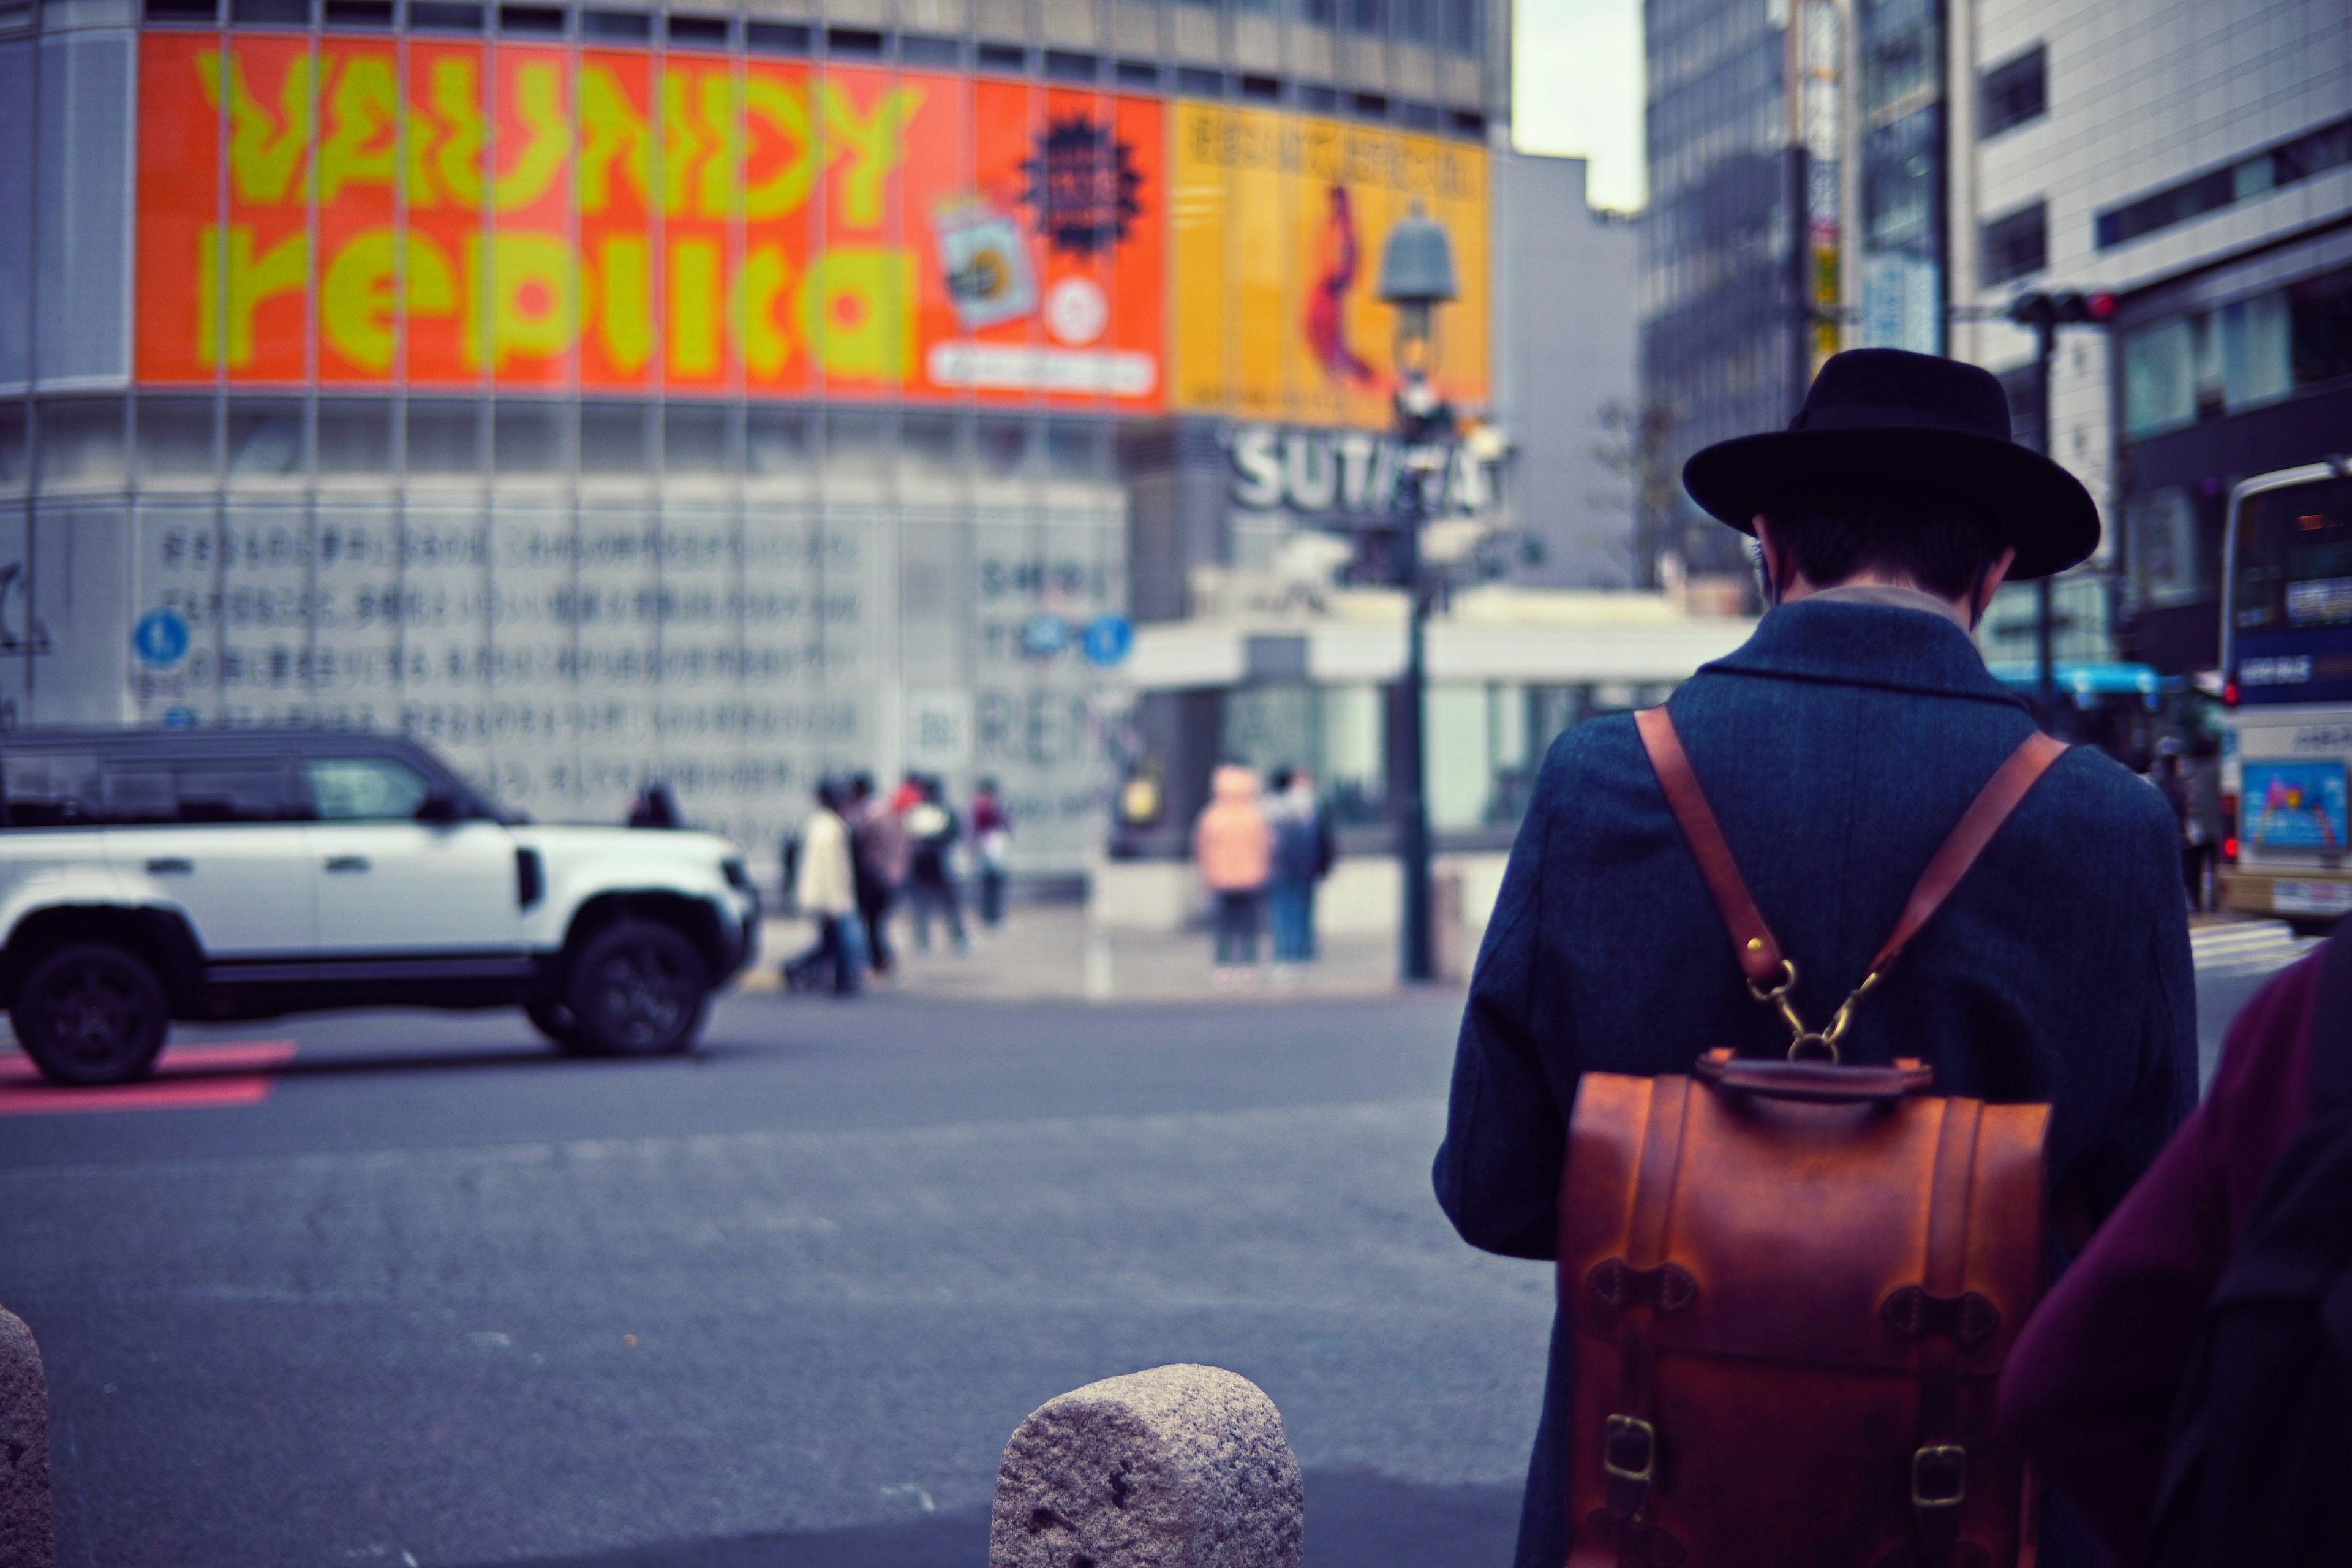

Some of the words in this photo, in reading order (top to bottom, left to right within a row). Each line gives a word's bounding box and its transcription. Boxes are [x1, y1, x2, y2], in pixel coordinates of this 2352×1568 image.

[195, 51, 926, 229] VAUNDY
[199, 226, 915, 382] replica
[1232, 428, 1496, 514] SUTAA
